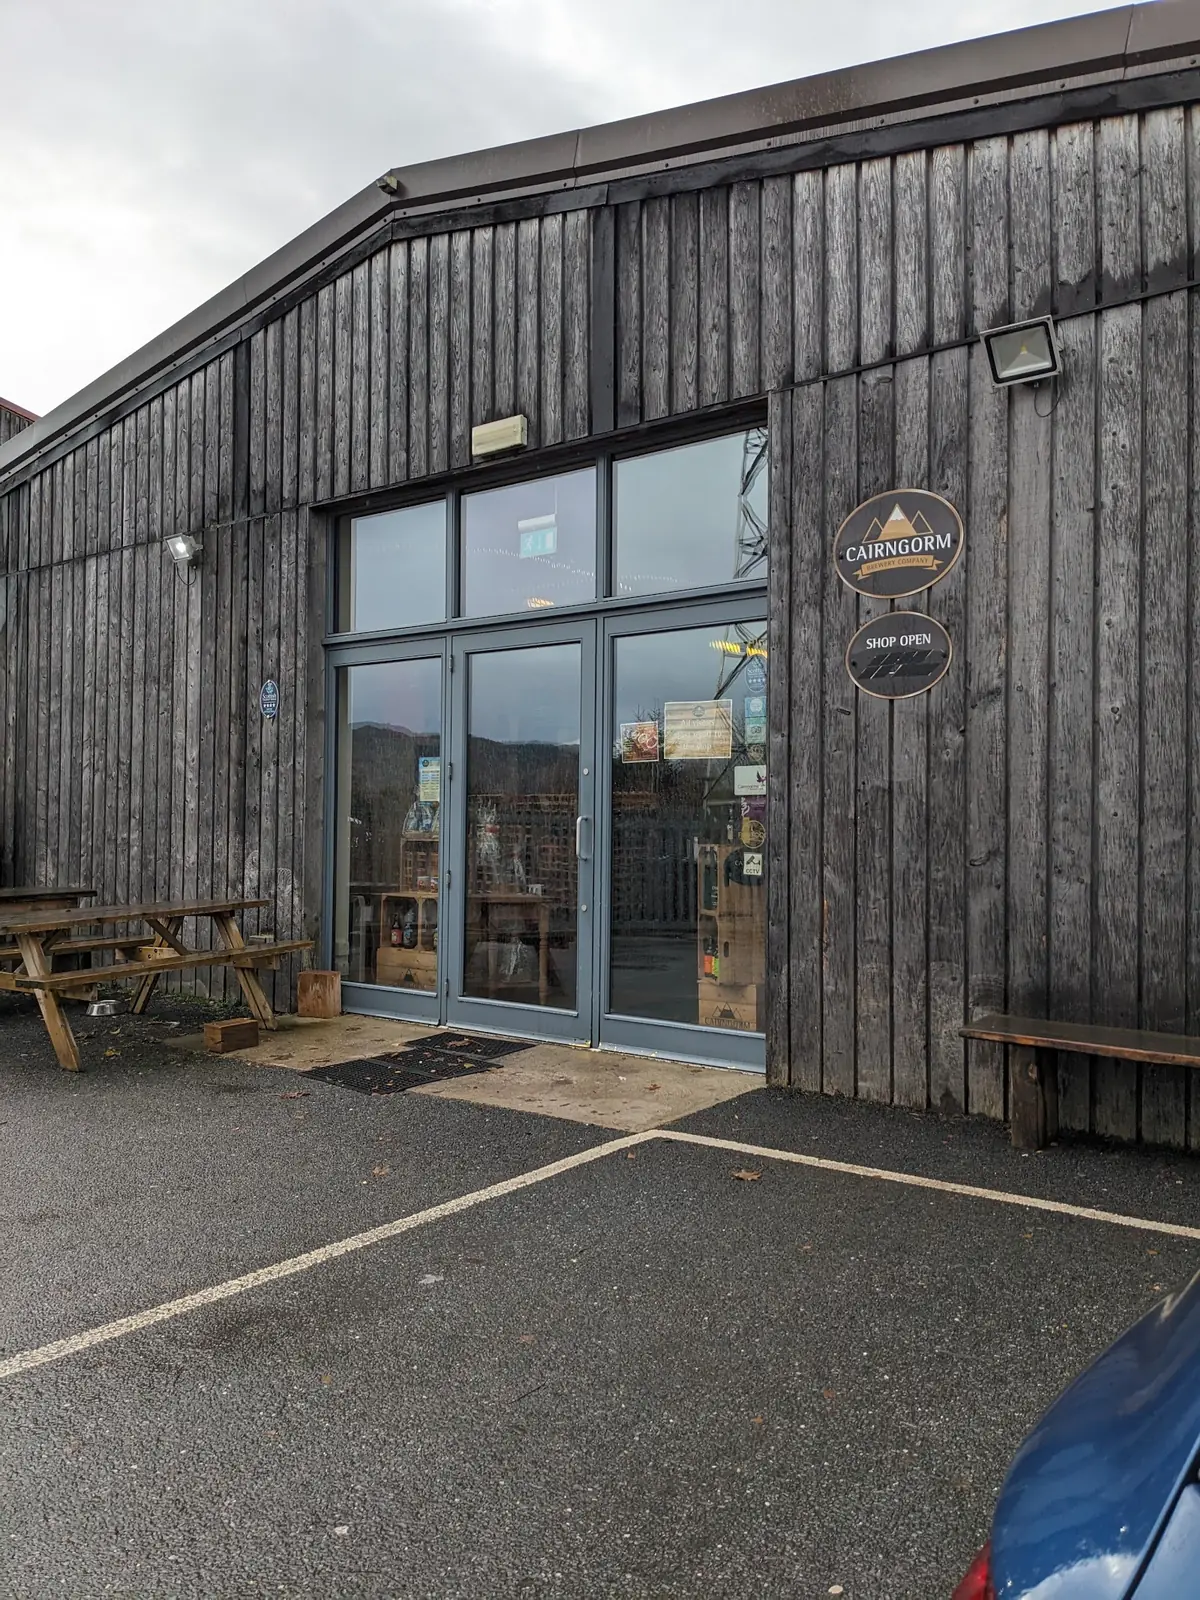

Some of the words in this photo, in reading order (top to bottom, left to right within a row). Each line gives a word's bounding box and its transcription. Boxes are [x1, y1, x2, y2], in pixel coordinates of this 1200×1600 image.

[846, 533, 951, 562] CAIRNGORM
[866, 560, 895, 571] BREWERY
[897, 557, 928, 567] COMPANY
[866, 637, 896, 650] SHOP
[899, 633, 931, 647] OPEN
